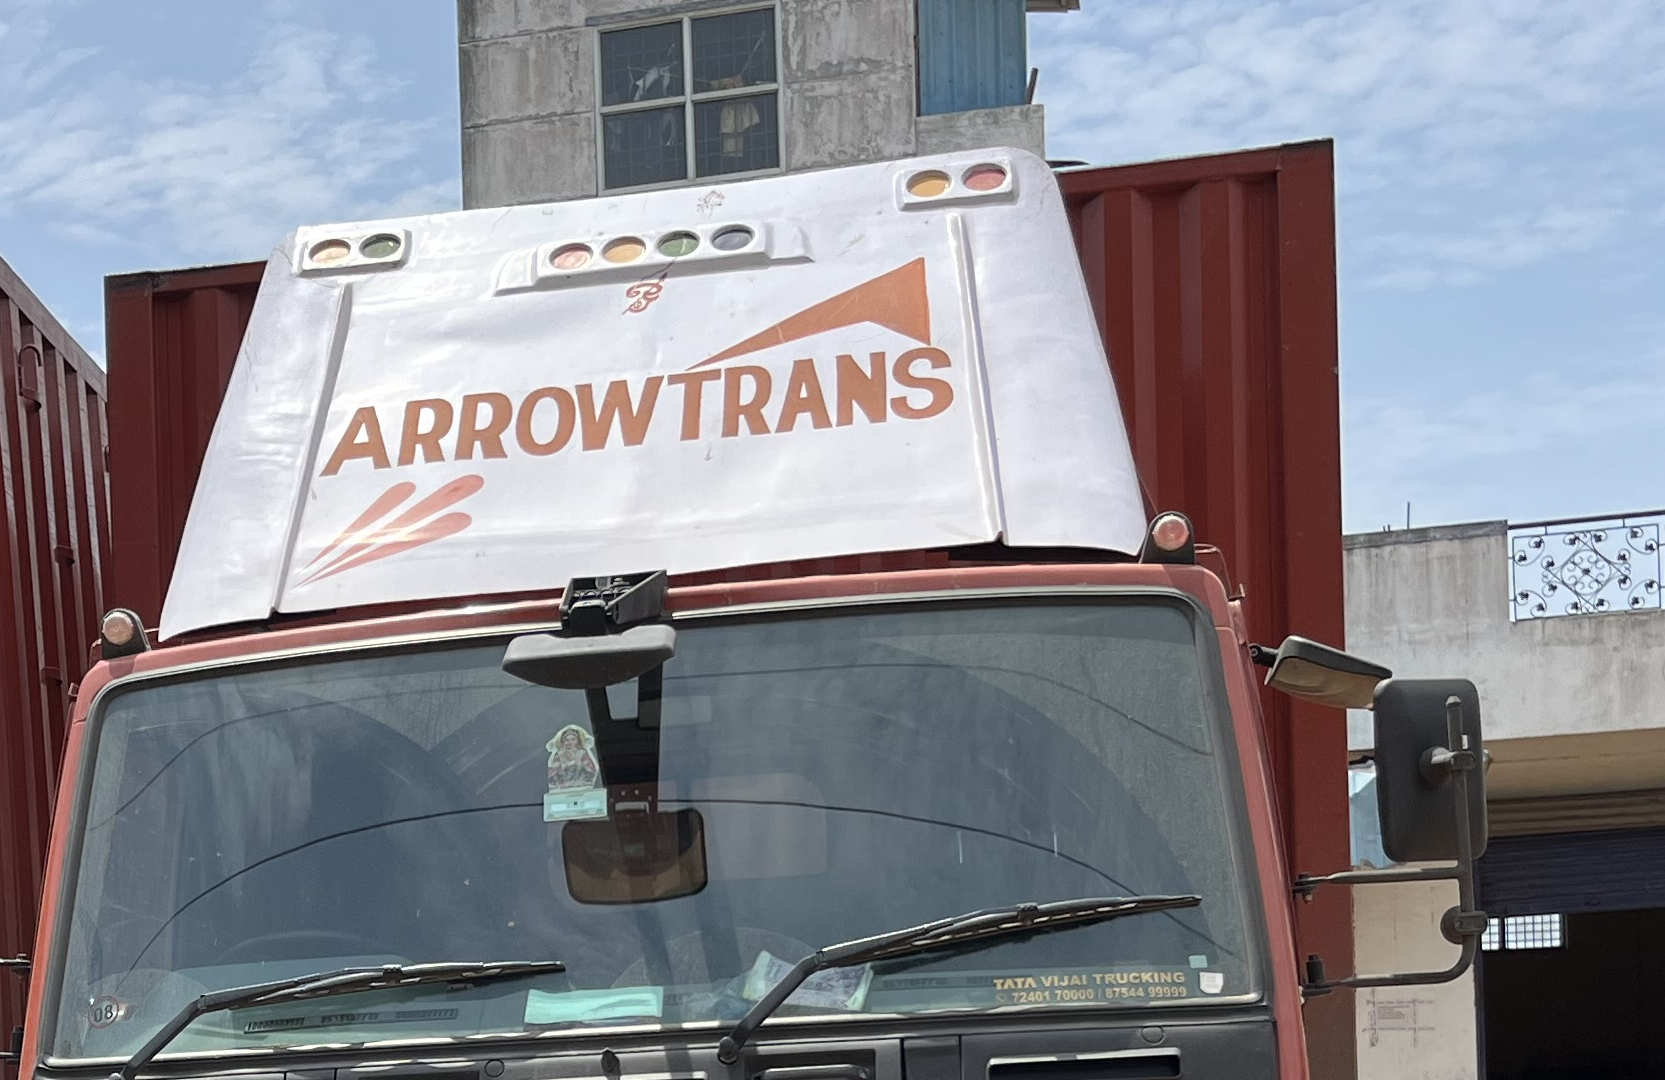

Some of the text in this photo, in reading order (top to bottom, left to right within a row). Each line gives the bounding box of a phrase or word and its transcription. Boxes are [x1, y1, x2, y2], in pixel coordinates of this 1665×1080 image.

[993, 972, 1186, 990] TATA VIJAI TRUCKING
[1012, 991, 1050, 1003] 72401
[1055, 989, 1094, 1001] 70000
[1105, 987, 1144, 999] 87544
[1148, 986, 1187, 998] 99999
[94, 1004, 113, 1022] 08
